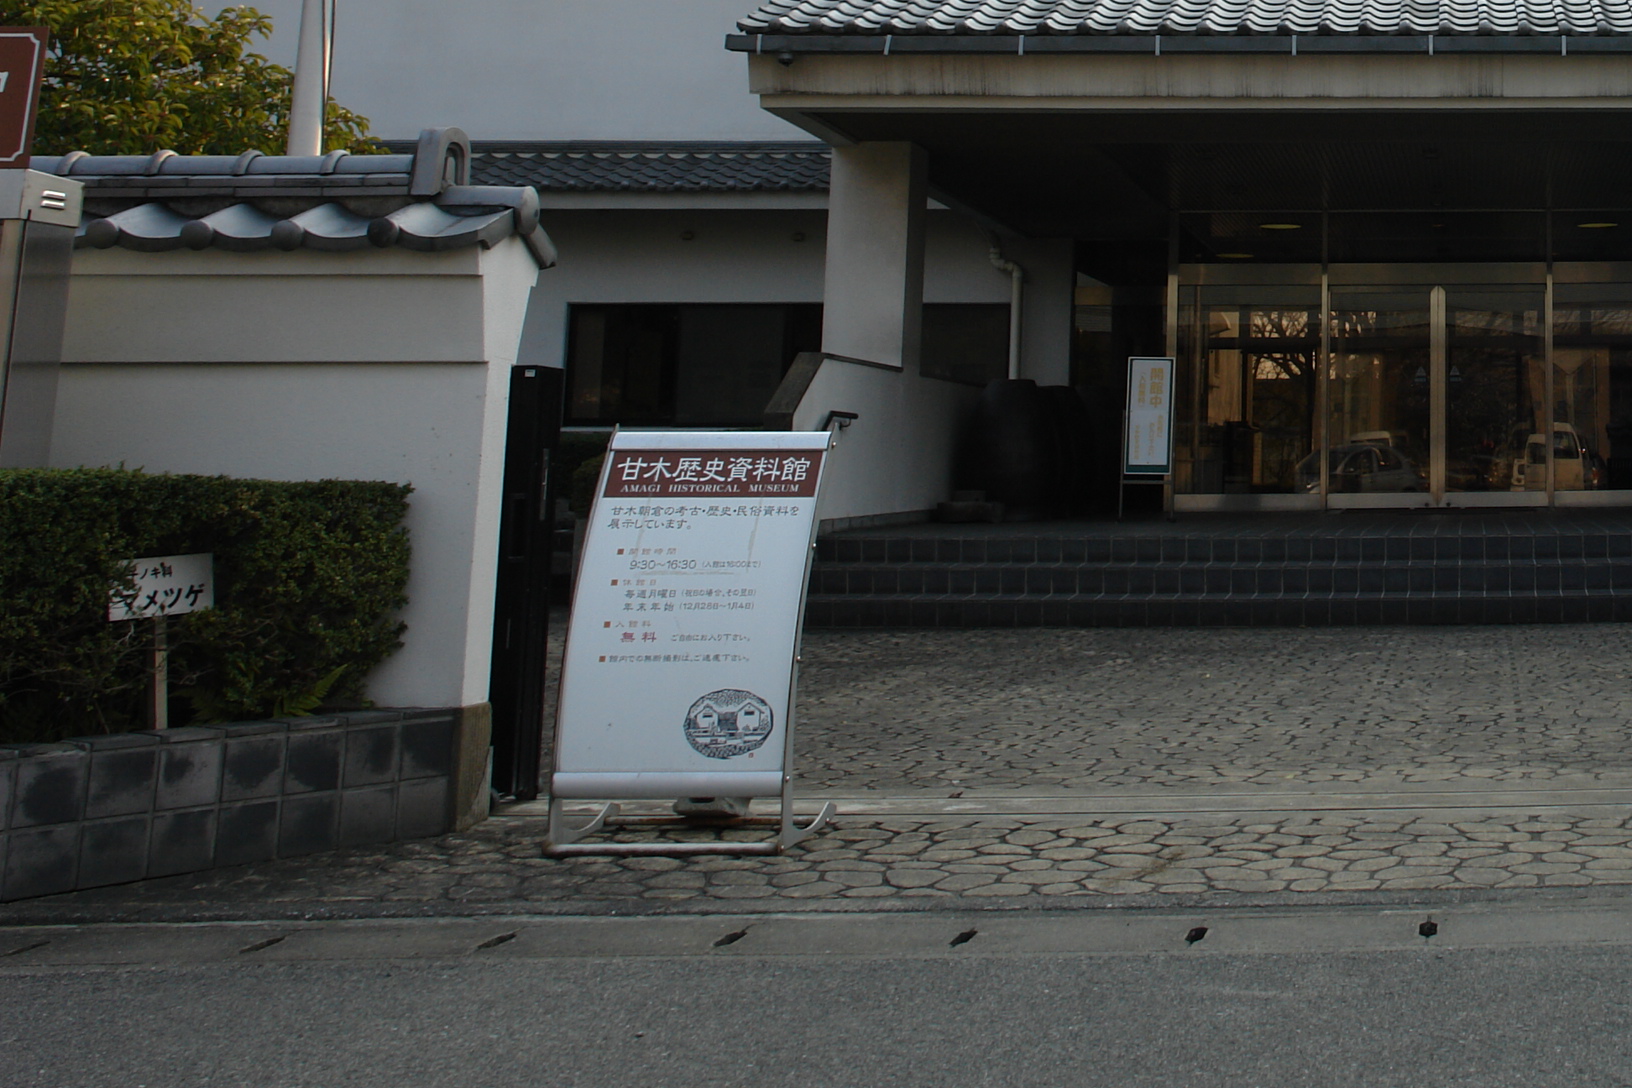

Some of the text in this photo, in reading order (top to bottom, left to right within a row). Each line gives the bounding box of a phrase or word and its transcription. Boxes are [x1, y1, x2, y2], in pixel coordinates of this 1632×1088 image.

[1150, 367, 1164, 408] 開館中
[617, 457, 811, 482] 甘木歴史資料館
[620, 484, 800, 493] AMAGI HISTORICAL MUSEUM
[611, 505, 800, 517] 甘木朝倉の考古・歴史・民俗資料を
[607, 518, 692, 530] 展示しています。
[628, 547, 677, 556] 開館時間
[622, 578, 657, 587] 休館日
[624, 589, 677, 599] 毎週月曜日
[623, 602, 675, 612] 年末年始
[615, 620, 652, 628] 入館料
[619, 631, 657, 643] 無料
